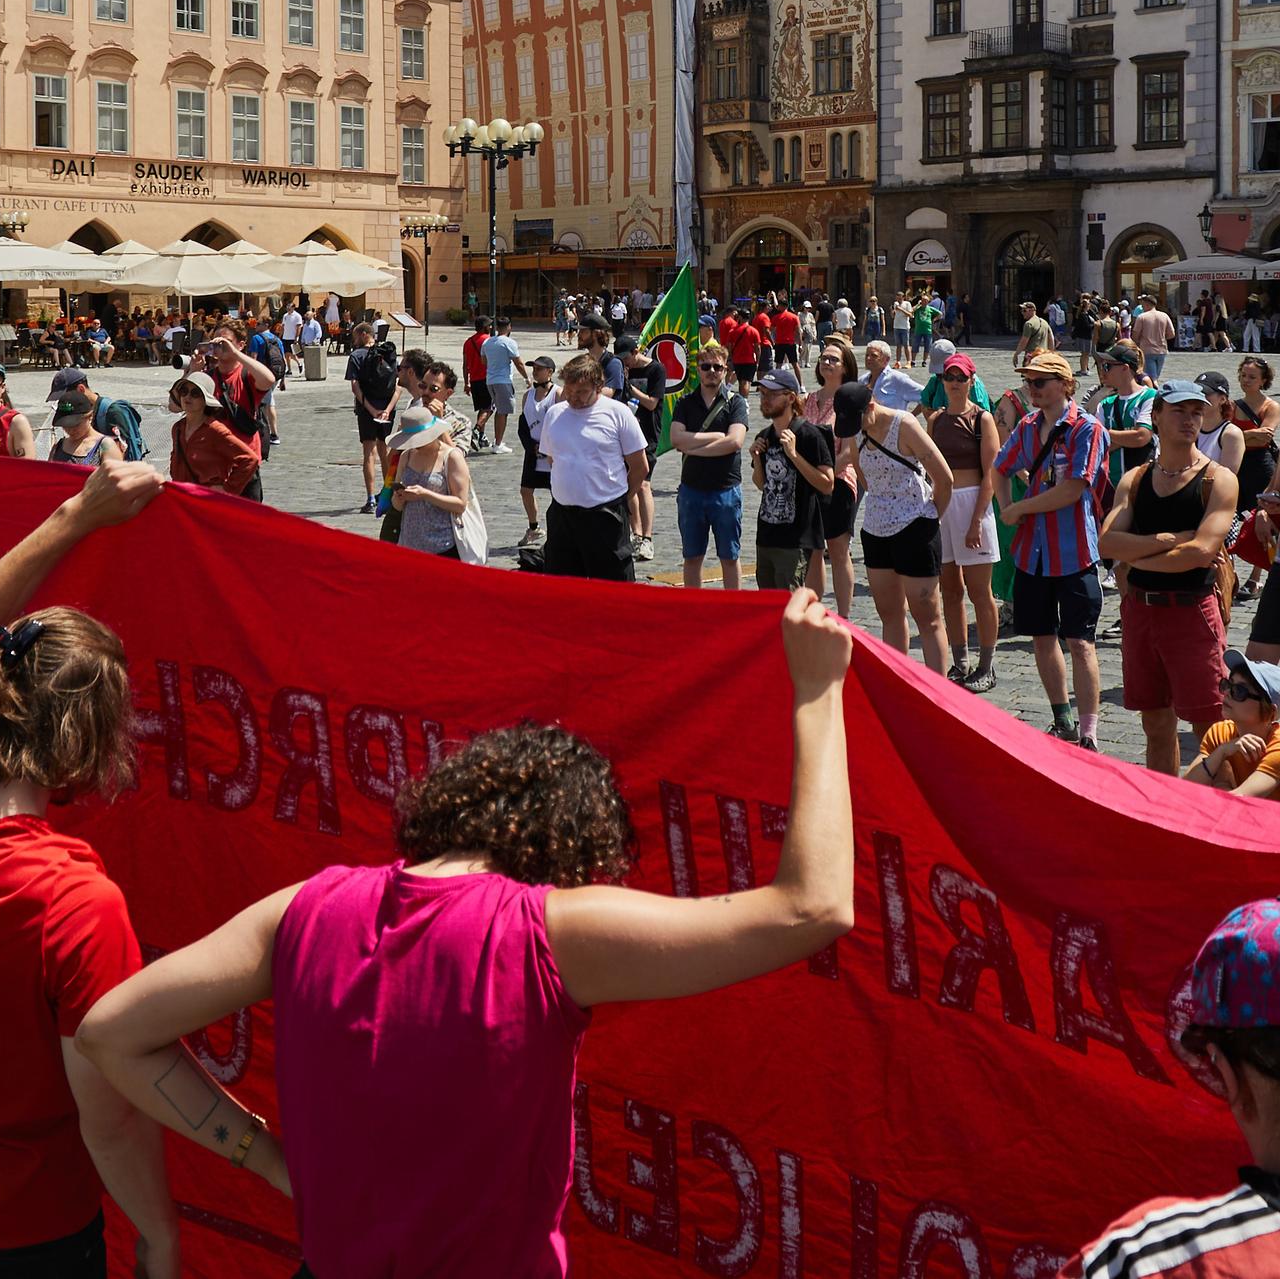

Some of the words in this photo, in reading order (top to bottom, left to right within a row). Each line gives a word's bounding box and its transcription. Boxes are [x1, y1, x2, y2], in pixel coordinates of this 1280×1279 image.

[52, 157, 96, 177] DALÍ
[134, 163, 204, 181] SAUDEK
[241, 168, 310, 188] WARHOL
[130, 182, 210, 197] exhibition
[1170, 273, 1192, 281] BREAKFAST
